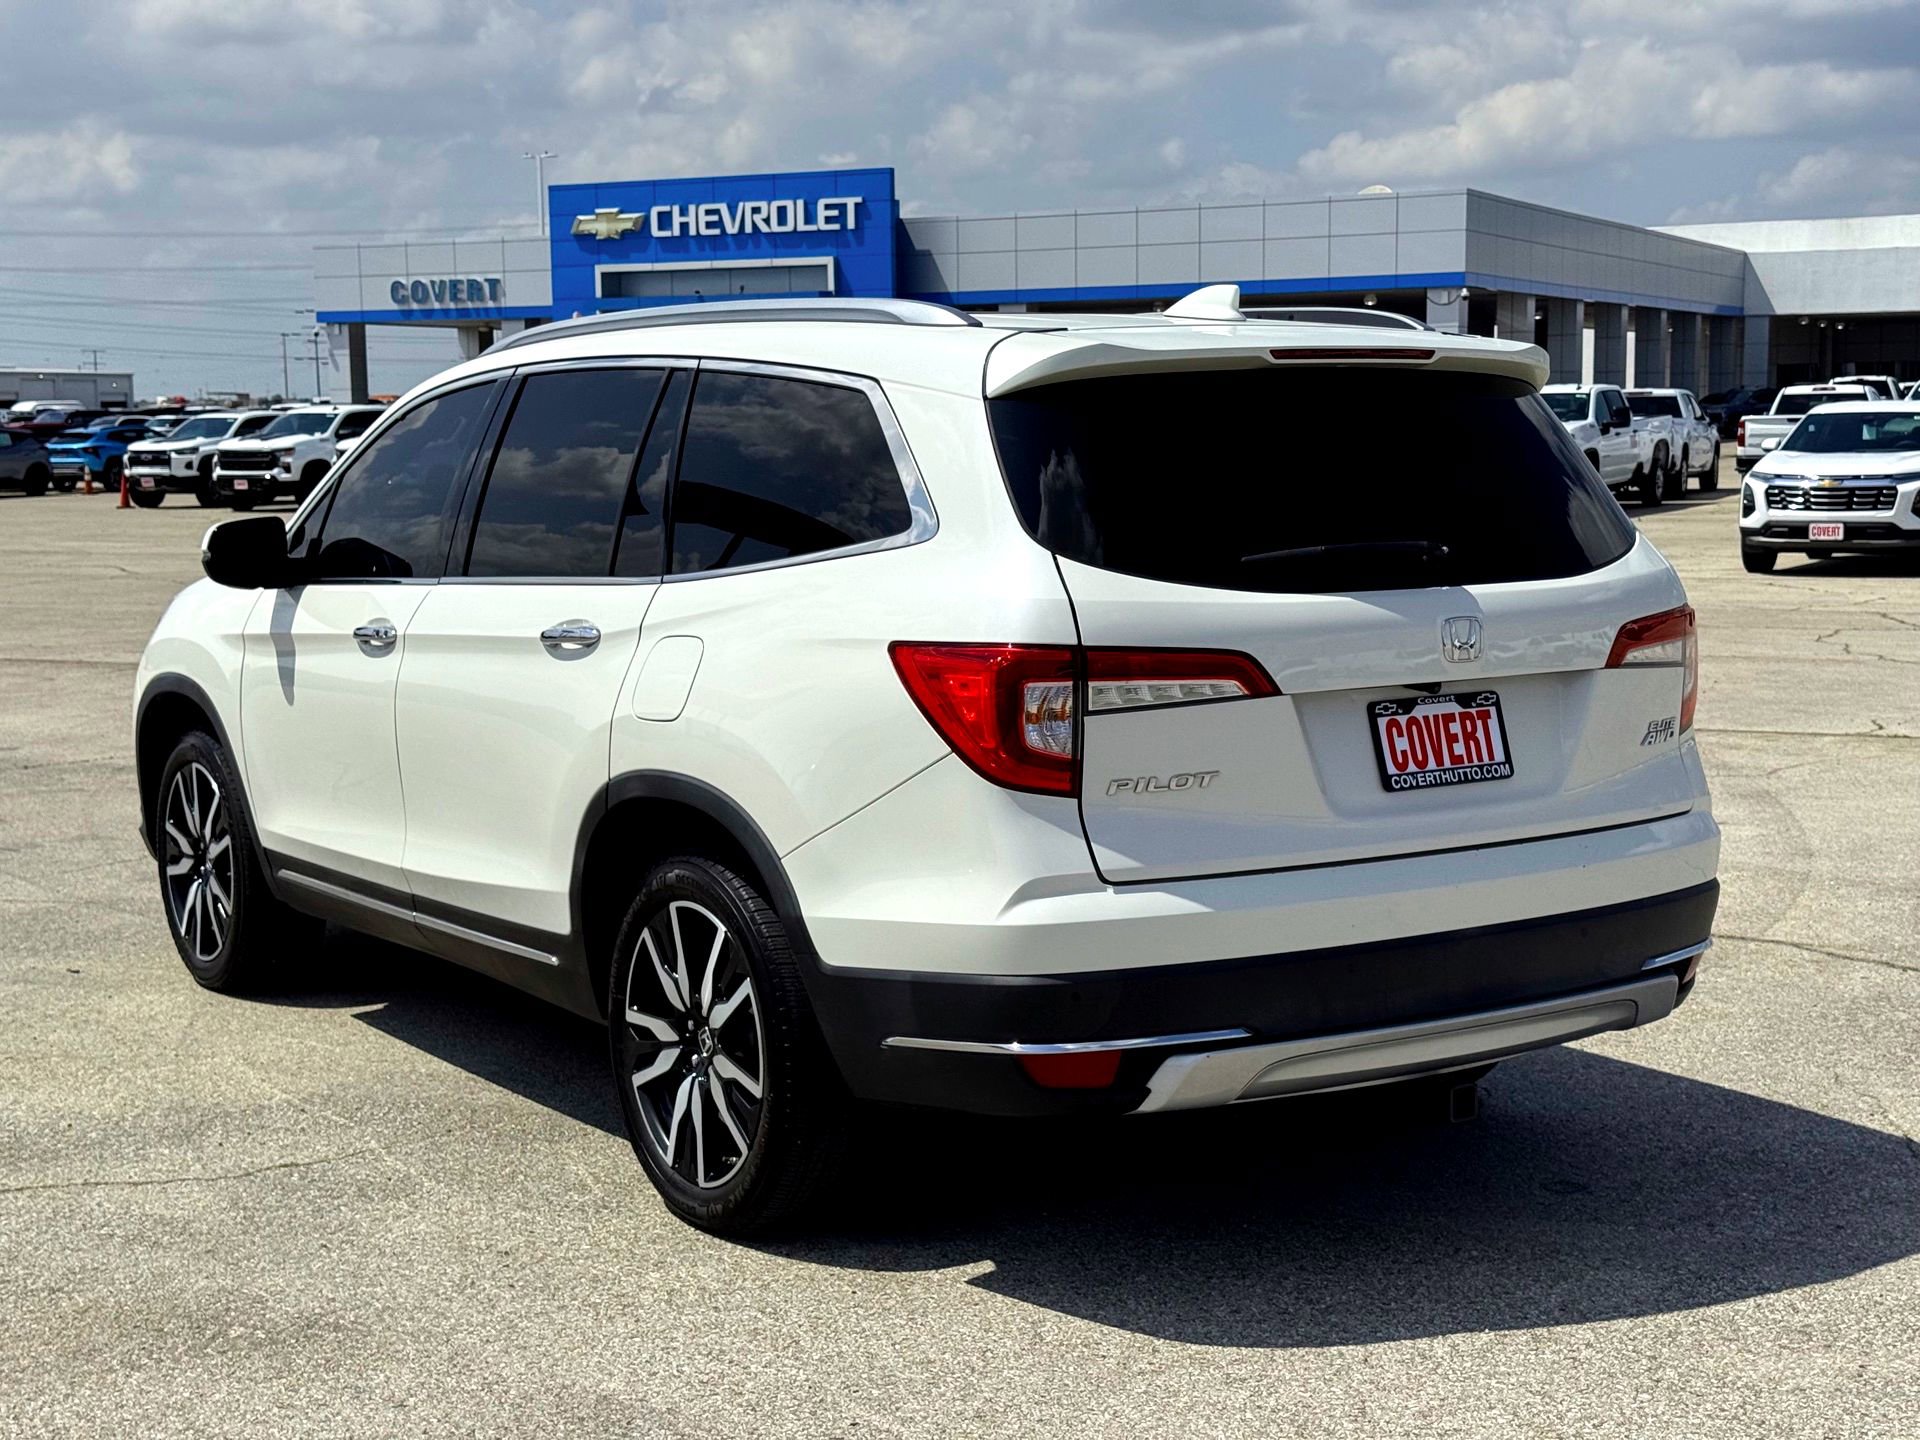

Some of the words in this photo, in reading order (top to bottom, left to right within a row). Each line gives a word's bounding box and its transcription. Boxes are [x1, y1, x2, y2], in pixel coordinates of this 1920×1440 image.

[650, 196, 863, 238] CHEVROLET
[390, 278, 502, 305] COVERT
[1811, 526, 1841, 537] COVERT
[1417, 695, 1456, 705] Covert
[1385, 709, 1496, 773] COVERT
[1106, 770, 1220, 796] PILOT
[1391, 763, 1511, 789] COVERTHUTTO.COM
